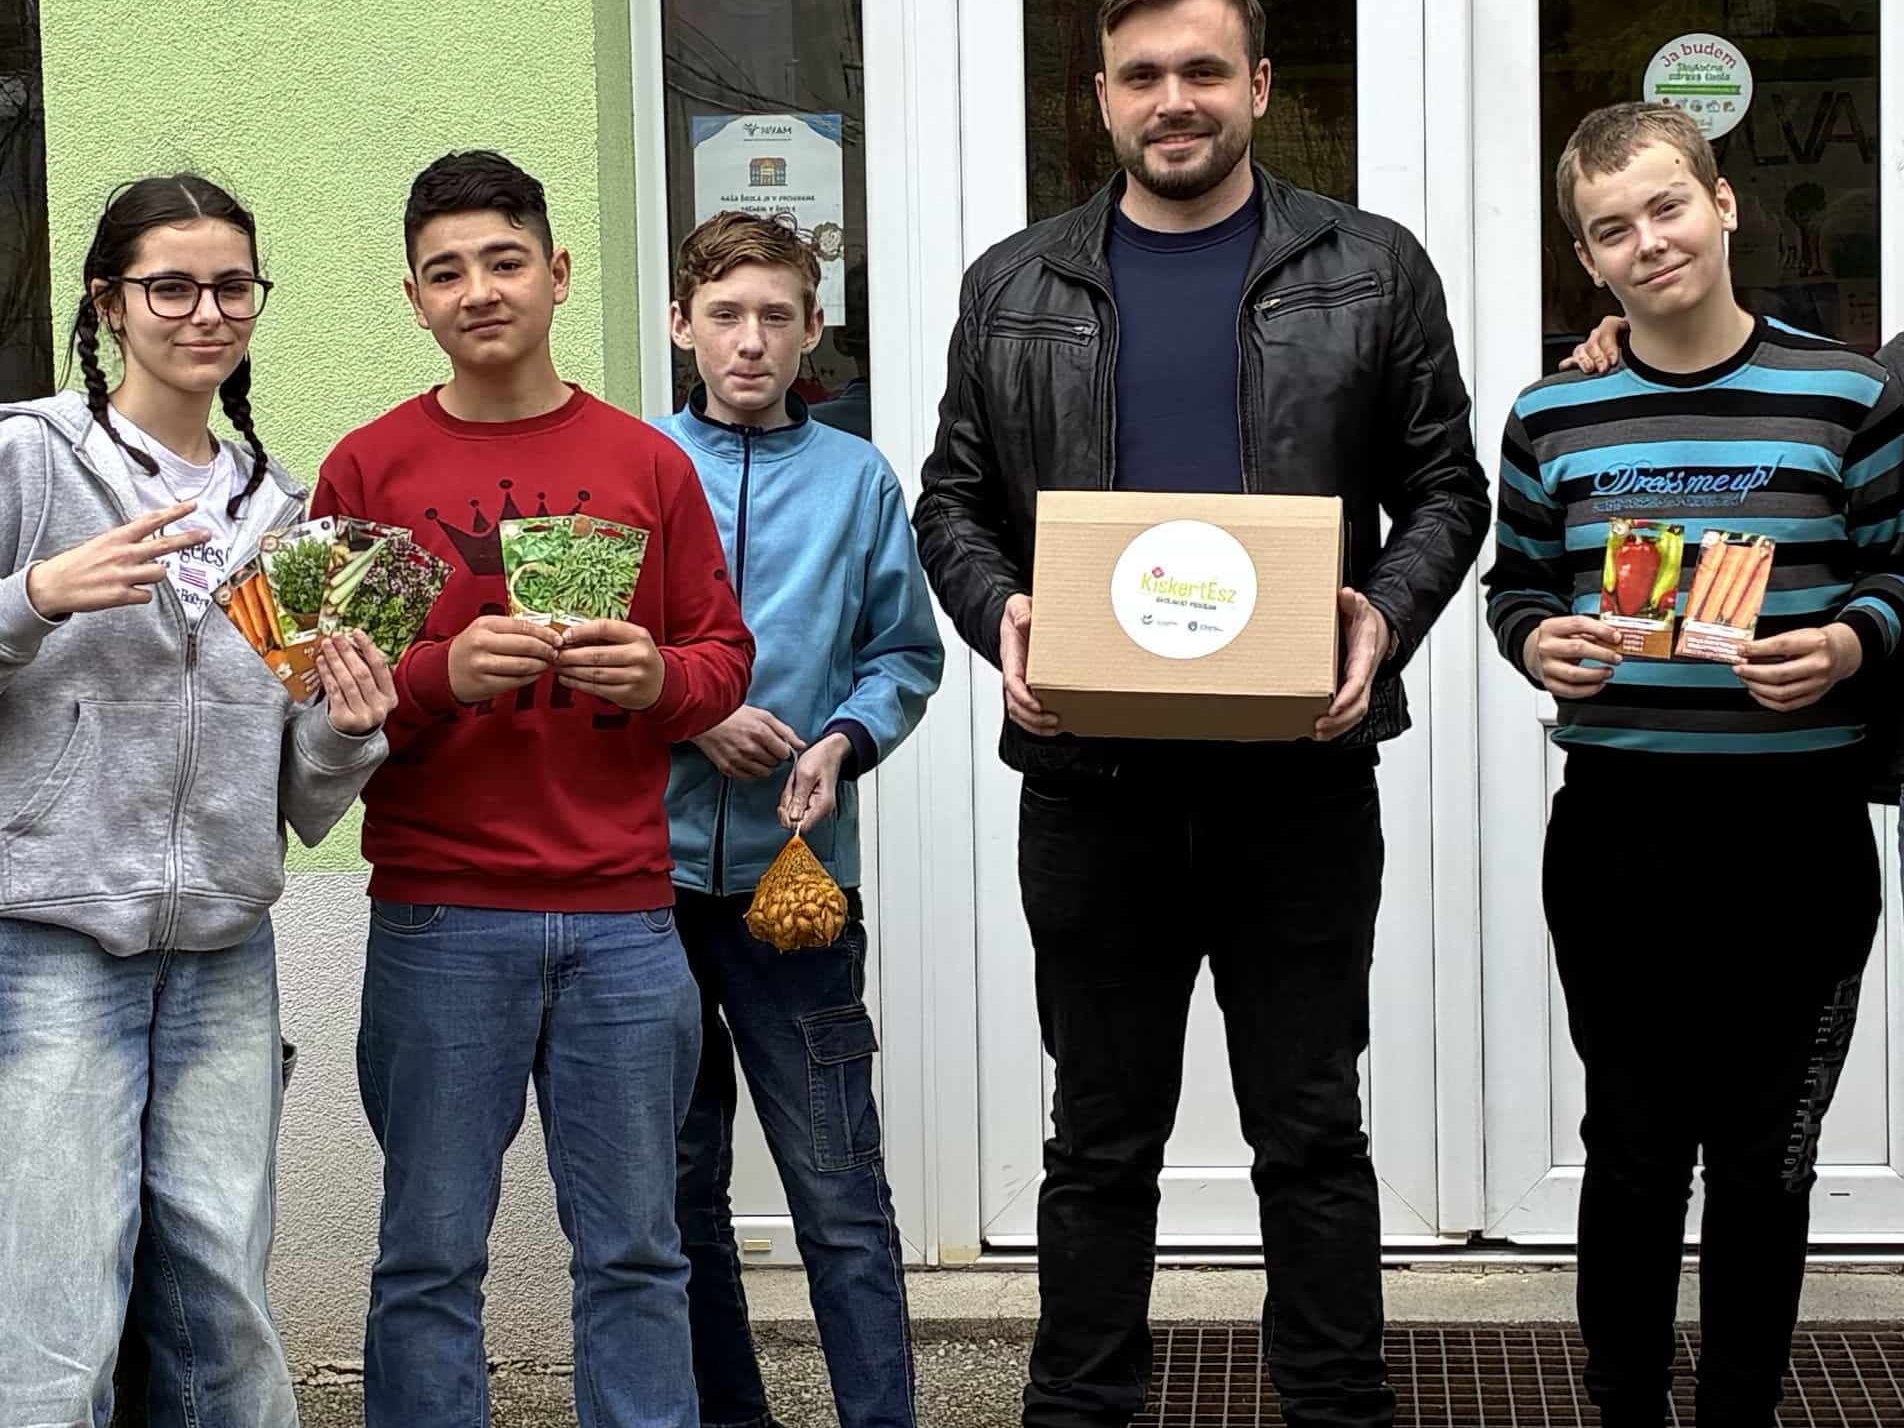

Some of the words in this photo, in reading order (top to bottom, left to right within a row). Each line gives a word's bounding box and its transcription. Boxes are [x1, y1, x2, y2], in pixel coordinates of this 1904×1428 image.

[1660, 50, 1681, 69] Ja
[1680, 42, 1738, 70] budem
[1684, 472, 1729, 494] me
